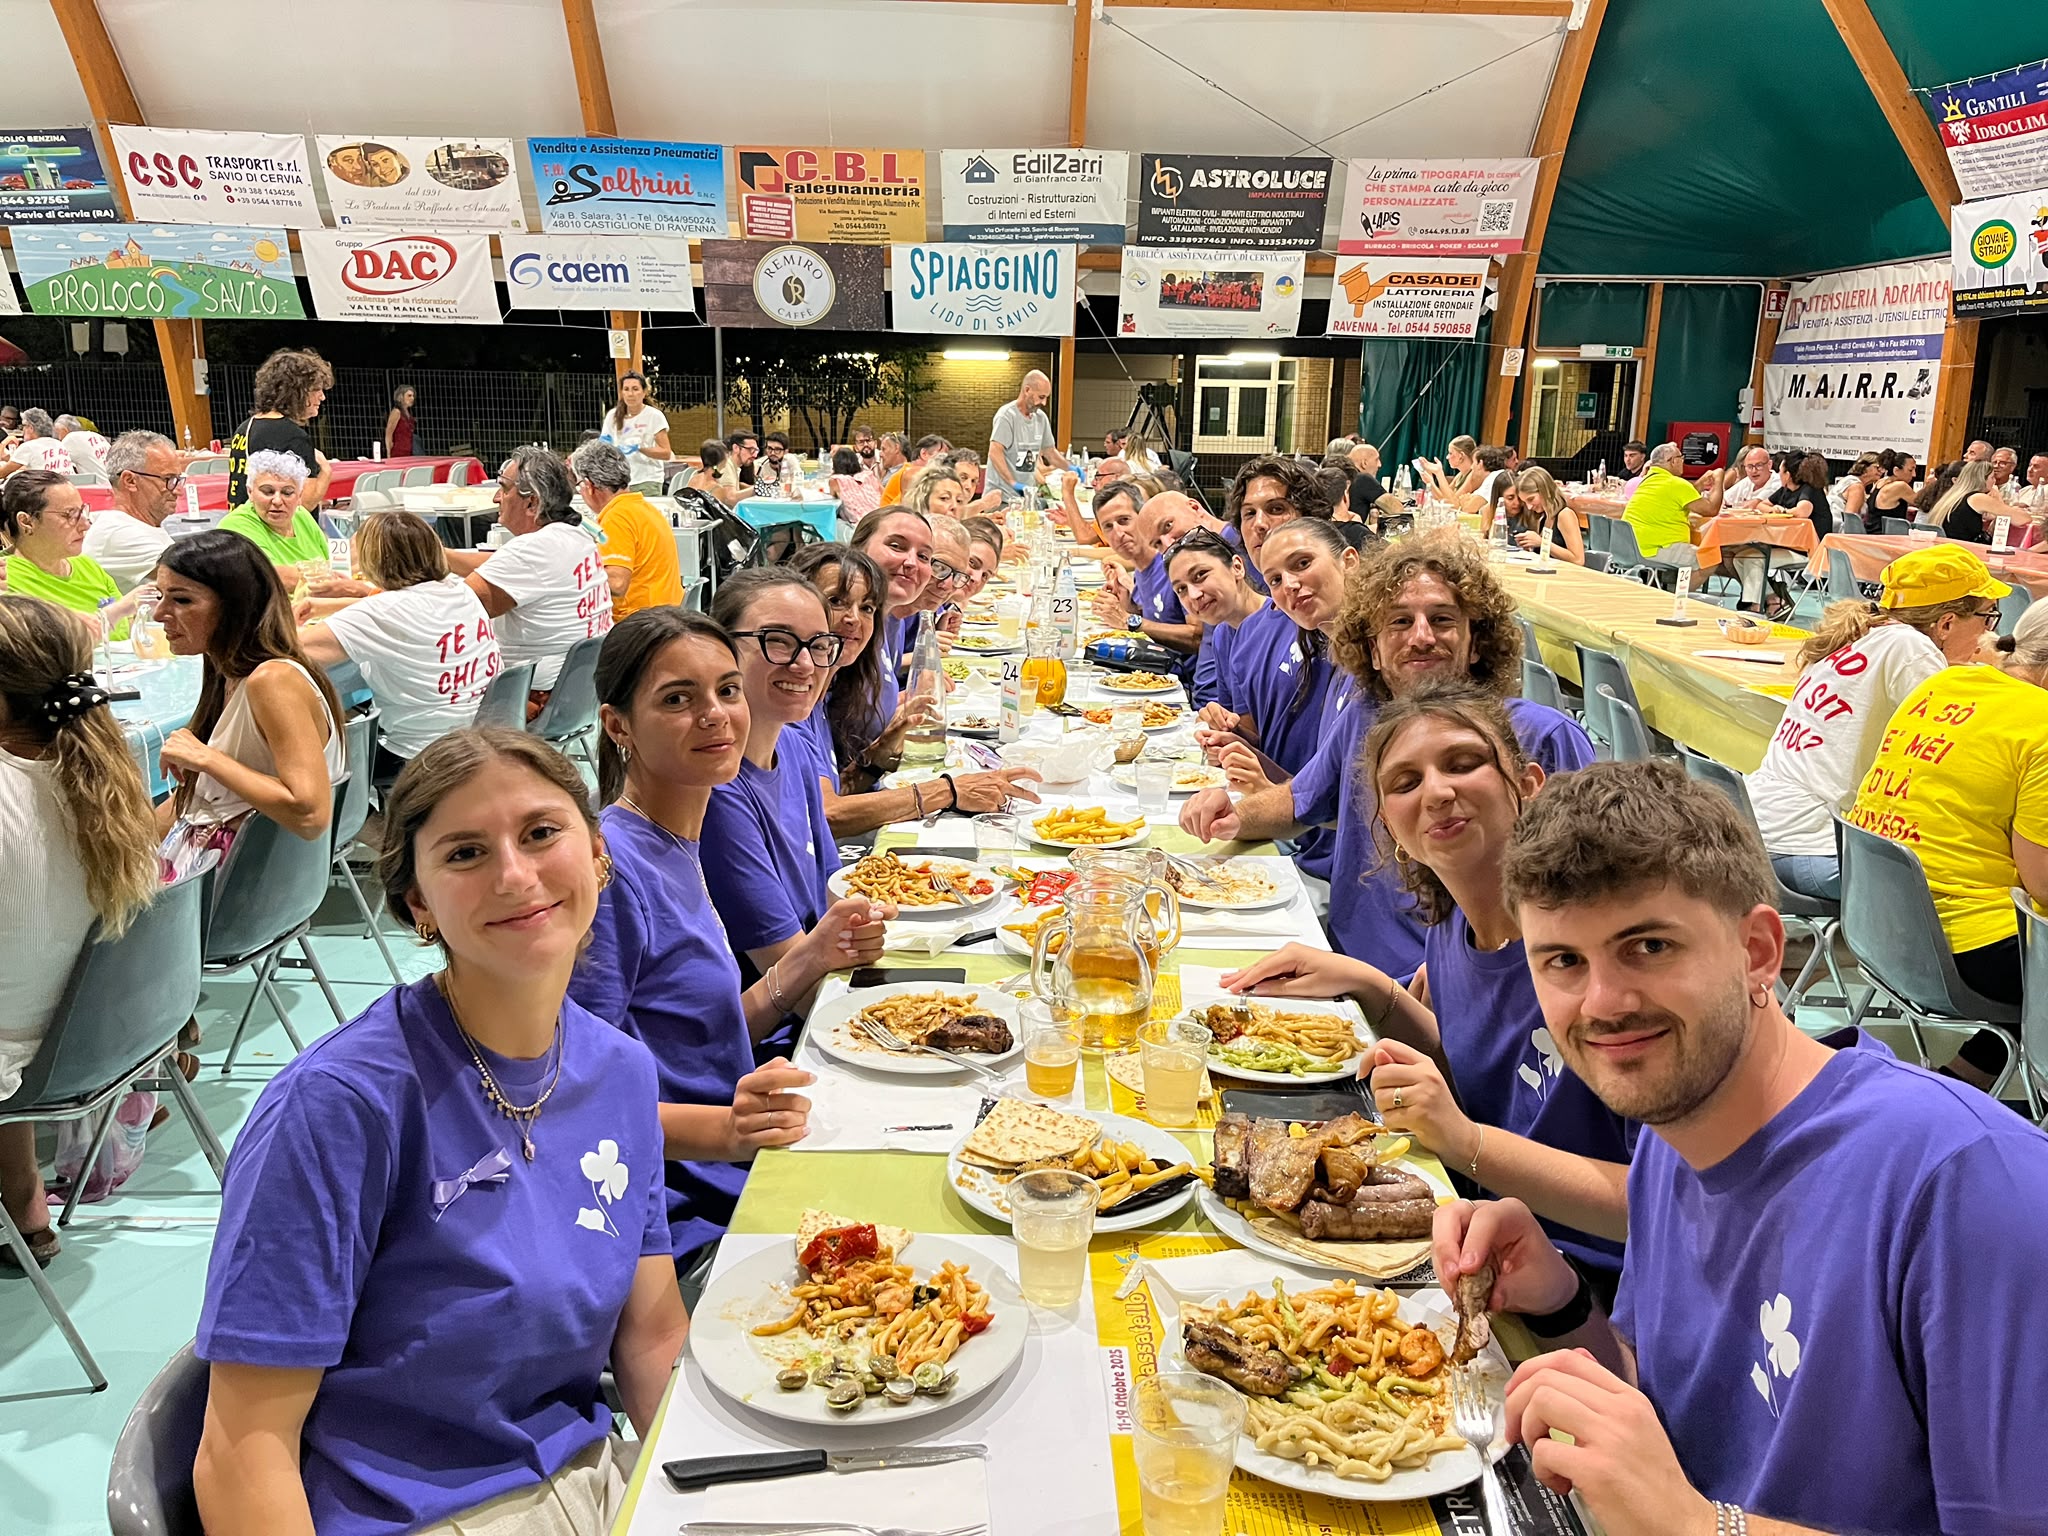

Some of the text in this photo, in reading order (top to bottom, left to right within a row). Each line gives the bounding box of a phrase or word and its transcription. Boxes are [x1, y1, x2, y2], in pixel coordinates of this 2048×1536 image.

[1966, 92, 2026, 116] GENTILI
[1973, 113, 2048, 140] IDROCLIM
[534, 142, 577, 154] Vendita
[590, 144, 650, 156] Assistenza
[654, 146, 718, 160] Pneumatici
[785, 151, 918, 184] C.B.L.
[1013, 154, 1102, 174] EdilZarri
[128, 152, 301, 190] CSC TRASPORTI s.r.l.
[209, 170, 303, 184] SAVIO DI CERVIA
[1382, 168, 1417, 183] prima
[1420, 170, 1484, 180] TIPOGRAFIA
[569, 164, 694, 199] Solfrini
[1014, 174, 1102, 183] di Gianfranco Zarri
[1190, 169, 1327, 189] ASTROLUCE
[264, 188, 296, 196] 1434256
[405, 186, 440, 196] dal 1991
[784, 183, 920, 196] Falegnameria
[1365, 180, 1510, 198] CHE STAMPA carte da gioco
[27, 196, 70, 204] 927563
[251, 198, 270, 206] 0544
[795, 197, 906, 208] Produzione Vendita Alluminio
[968, 194, 1096, 204] Costruzioni Ristrutturazioni
[1363, 198, 1458, 206] PERSONALIZZATE.
[364, 200, 510, 213] Piadina Antonella
[1152, 208, 1176, 216] IMPIANTI
[1176, 208, 1201, 216] ELETTRICI
[1221, 210, 1245, 218] IMPIANTI
[4, 212, 14, 220] 4,
[46, 210, 55, 218] di
[60, 210, 90, 218] Cervia
[93, 209, 114, 218] (RA)
[550, 212, 566, 220] Via
[568, 212, 578, 220] B.
[658, 214, 716, 225] 0544/950243
[988, 209, 1076, 220] di Interni ed Esterni
[1162, 216, 1293, 226] AUTOMAZIONI CONDIZIONAMENTO IMPIANTI TV
[552, 220, 716, 233] 48010 CASTIGLIONE DI RAVENNA
[1209, 226, 1282, 234] RIVELAZIONE ANTINCENDIO
[336, 240, 362, 248] Gruppo
[1168, 236, 1226, 244] 3338927463
[1978, 232, 2008, 246] GIOVANE
[546, 252, 628, 262] GRUPPO
[1126, 250, 1278, 262] PUBBLICA ASSISTENZA DI CERVIA
[1979, 244, 2007, 258] STRADA
[351, 250, 438, 280] DAC
[764, 254, 822, 279] REMIRO
[548, 262, 630, 283] caem
[910, 248, 1058, 300] SPIAGGINO
[1388, 275, 1478, 286] CASADEI
[49, 274, 278, 314] PROLOCO SAVIO
[1386, 289, 1475, 297] LATTONERIA
[1883, 278, 1952, 305] ADRIATICA
[388, 297, 400, 305] per
[411, 297, 458, 306] ristorazione
[1373, 300, 1474, 310] INSTALLAZIONE GRONDAIE
[350, 304, 458, 314] VALTER MANCINELLI
[1388, 310, 1456, 318] COPERTURA TETTI
[930, 302, 1038, 331] LIDO DI SAVIO
[1802, 312, 1910, 328] VENDITA ASSISTENZA UTENSILI
[1333, 320, 1472, 334] RAVENNA Tel. 0544 590858
[1788, 372, 1904, 398] M.A.I.R.R.
[42, 448, 54, 460] TE
[45, 460, 60, 470] CHI
[1998, 518, 2008, 526] 29
[332, 540, 348, 554] 20
[573, 557, 592, 590] TE
[1680, 570, 1690, 582] 26
[1053, 599, 1072, 613] 23
[436, 623, 466, 663] TE
[438, 658, 478, 694] CHI
[1004, 662, 1018, 682] 24
[1804, 683, 1853, 722] SIT
[1109, 1349, 1132, 1431] 11-19 Ottobre 2025
